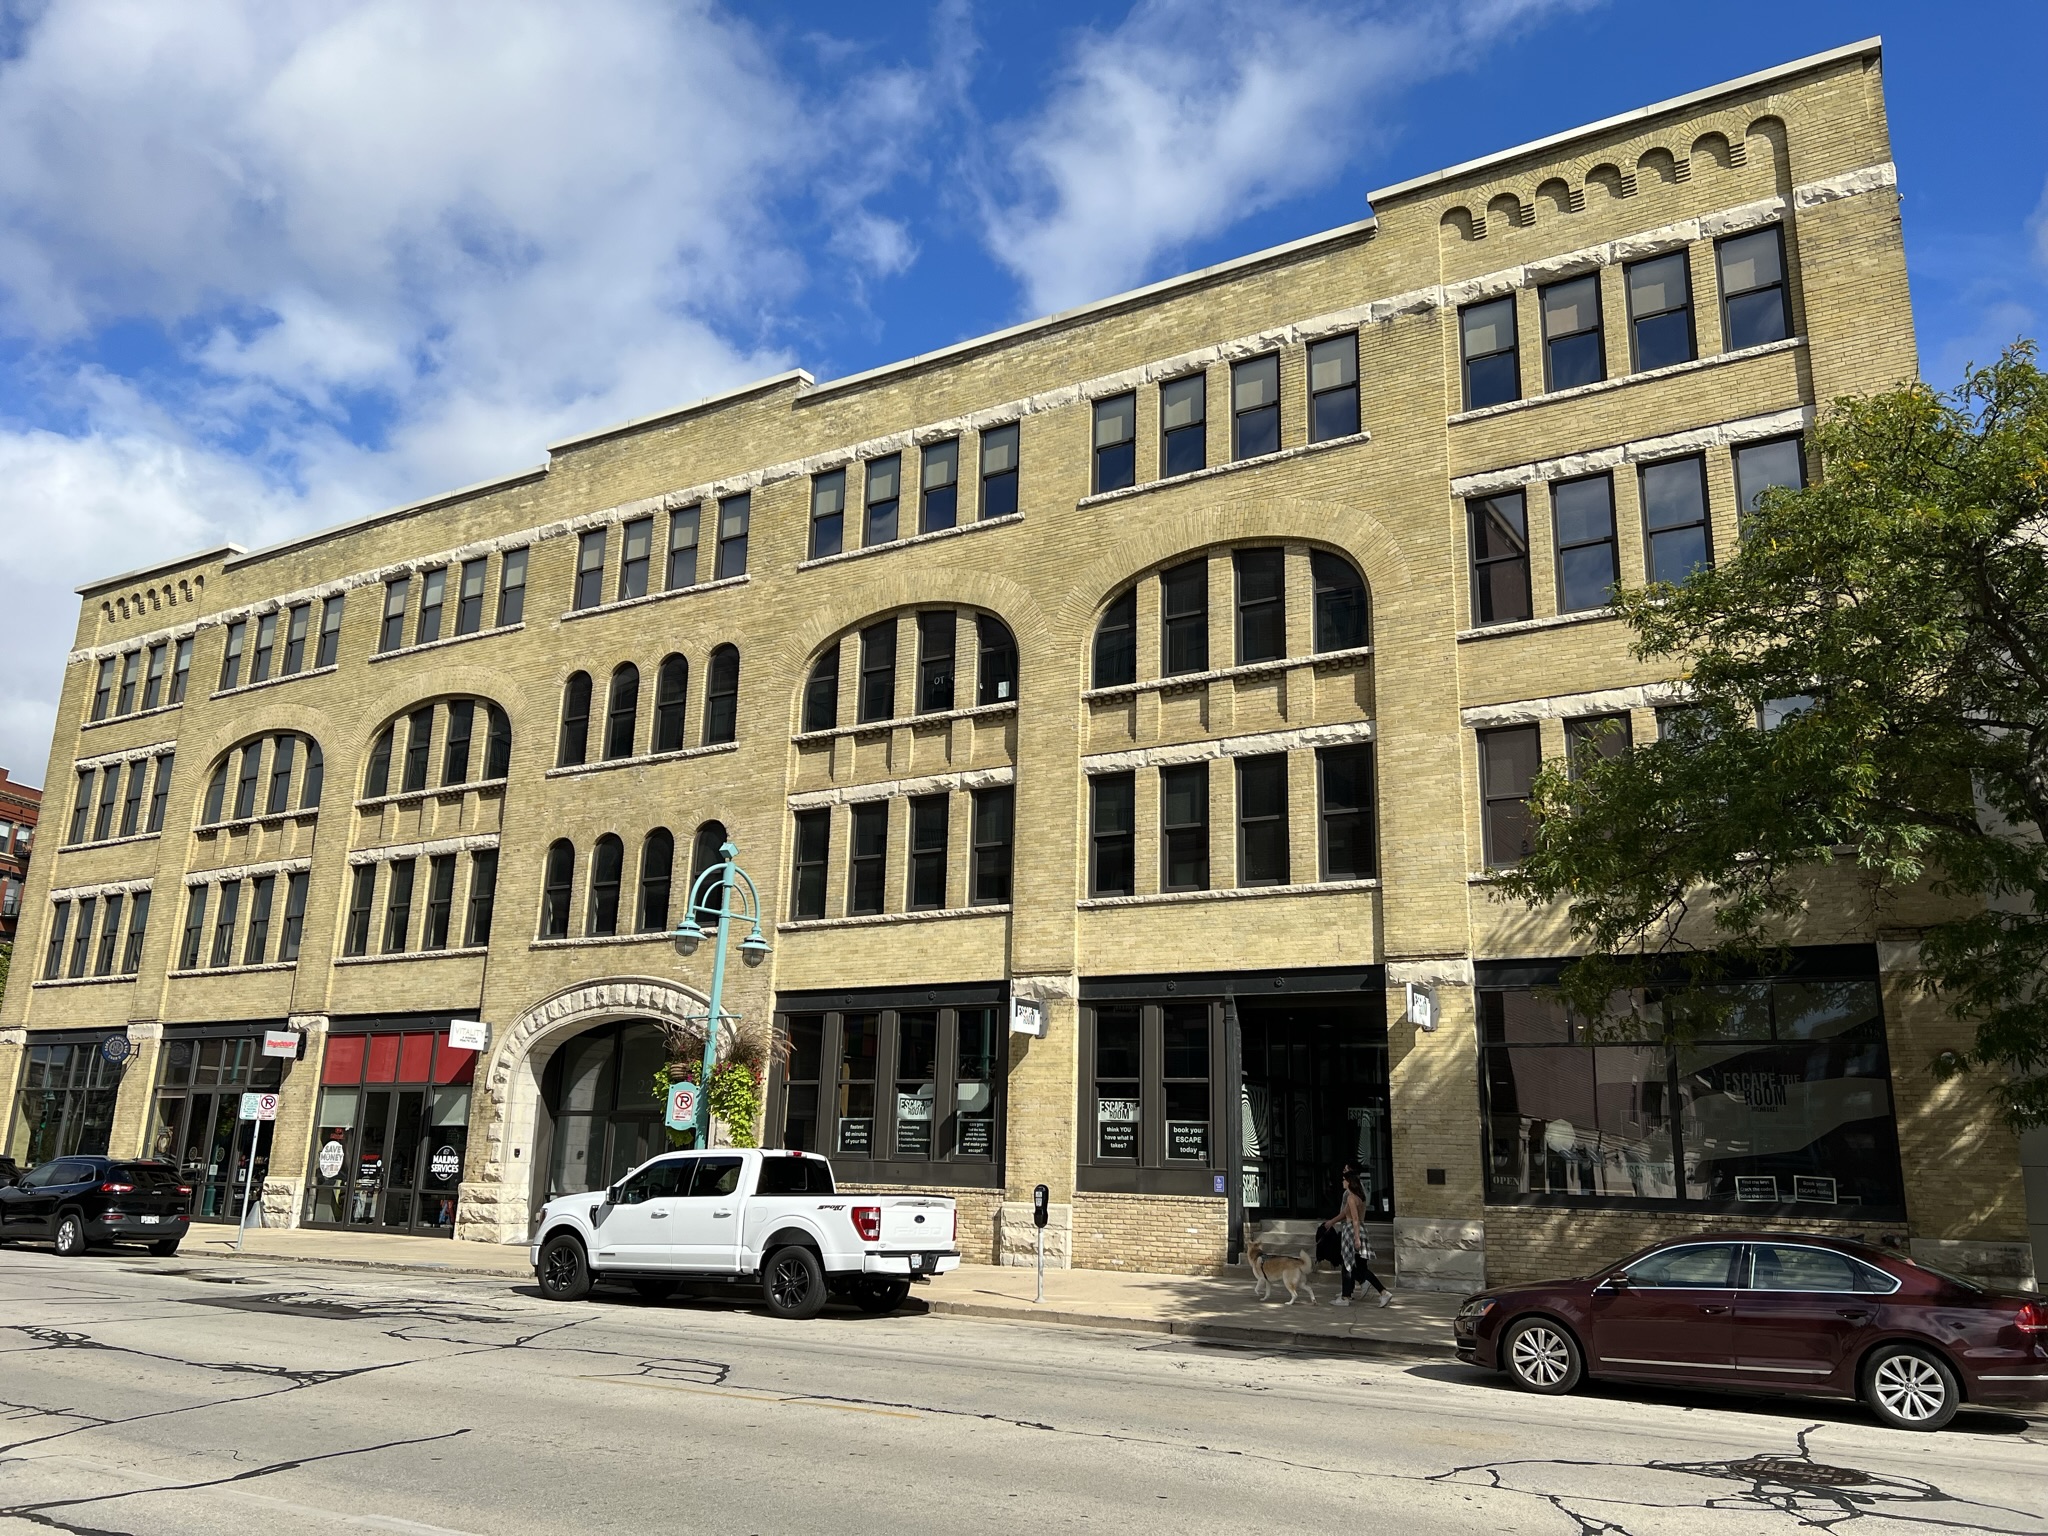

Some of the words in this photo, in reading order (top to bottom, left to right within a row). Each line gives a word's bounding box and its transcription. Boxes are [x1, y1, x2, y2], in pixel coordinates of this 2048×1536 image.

[455, 1027, 485, 1036] VITALITY
[1723, 1072, 1775, 1092] ESCAPE
[1779, 1074, 1801, 1085] THE
[1744, 1084, 1788, 1106] ROOM
[901, 1099, 922, 1111] ESCAPE
[1100, 1101, 1124, 1112] ESCAPE
[907, 1106, 926, 1116] ROOM
[1109, 1109, 1130, 1119] ROOM
[324, 1145, 342, 1153] SAVE
[320, 1153, 343, 1161] MONEY
[433, 1155, 459, 1164] MAILING
[431, 1164, 459, 1173] SERVICES
[1493, 1175, 1520, 1186] OPEN
[894, 1226, 942, 1237] F-150
